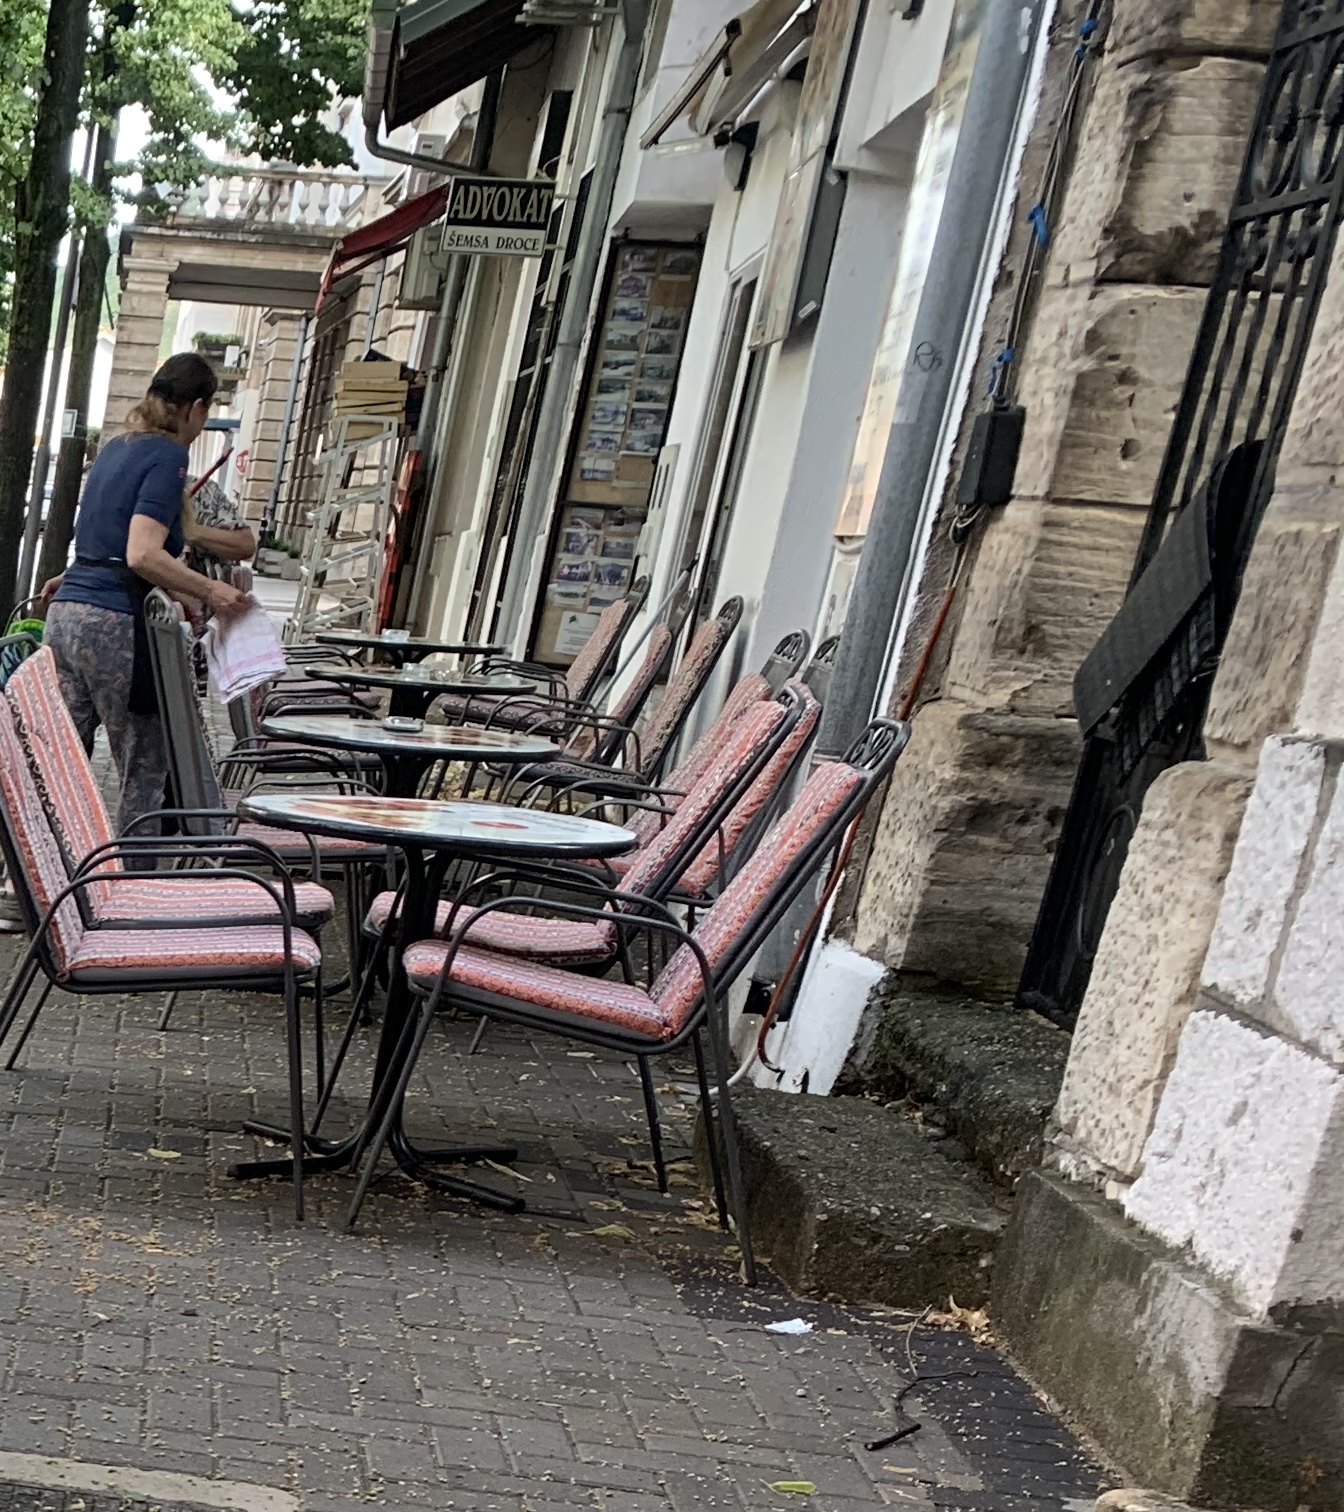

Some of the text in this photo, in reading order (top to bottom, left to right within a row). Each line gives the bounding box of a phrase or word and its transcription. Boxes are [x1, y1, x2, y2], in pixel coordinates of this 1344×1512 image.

[449, 184, 554, 223] ADVOKAT
[447, 230, 541, 252] ŠEMSA DROCE
